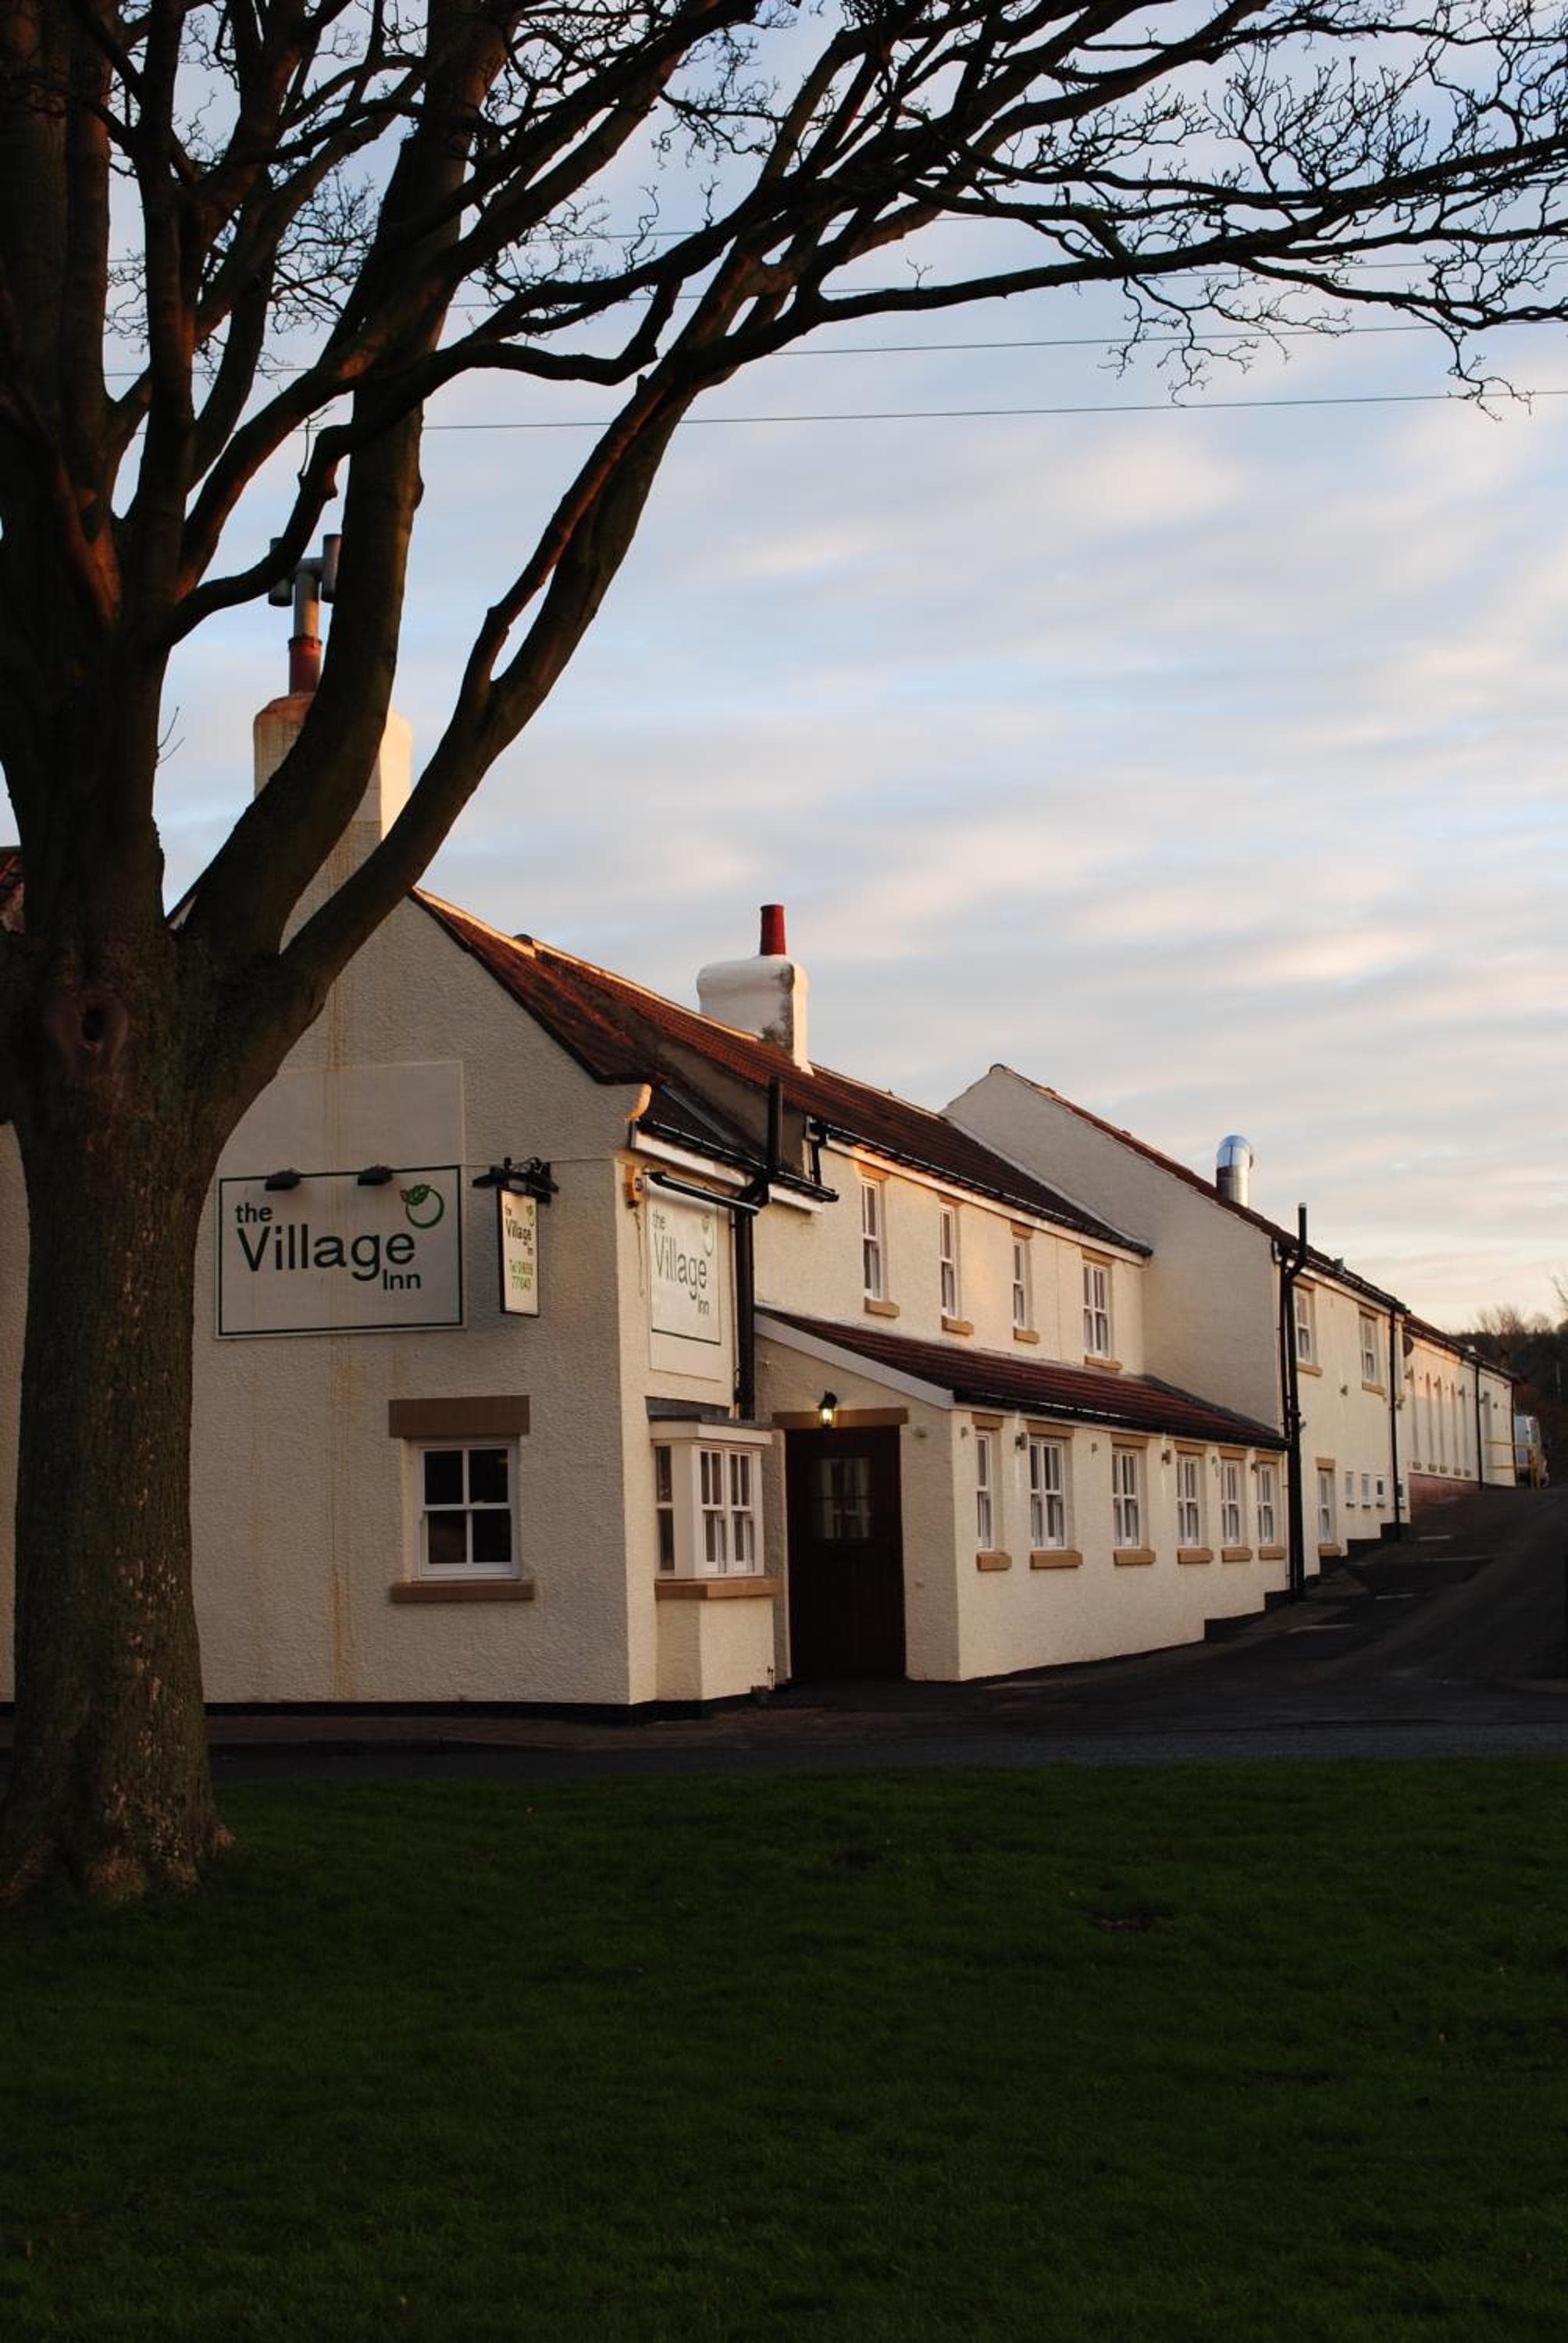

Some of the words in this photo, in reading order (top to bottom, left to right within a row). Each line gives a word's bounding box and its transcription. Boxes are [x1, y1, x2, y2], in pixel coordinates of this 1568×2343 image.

[236, 1203, 273, 1223] the
[652, 1209, 665, 1230] the
[506, 1218, 532, 1246] Village
[237, 1224, 415, 1282] Village
[654, 1232, 707, 1300] Village
[382, 1269, 421, 1290] Inn
[697, 1293, 710, 1315] Inn
